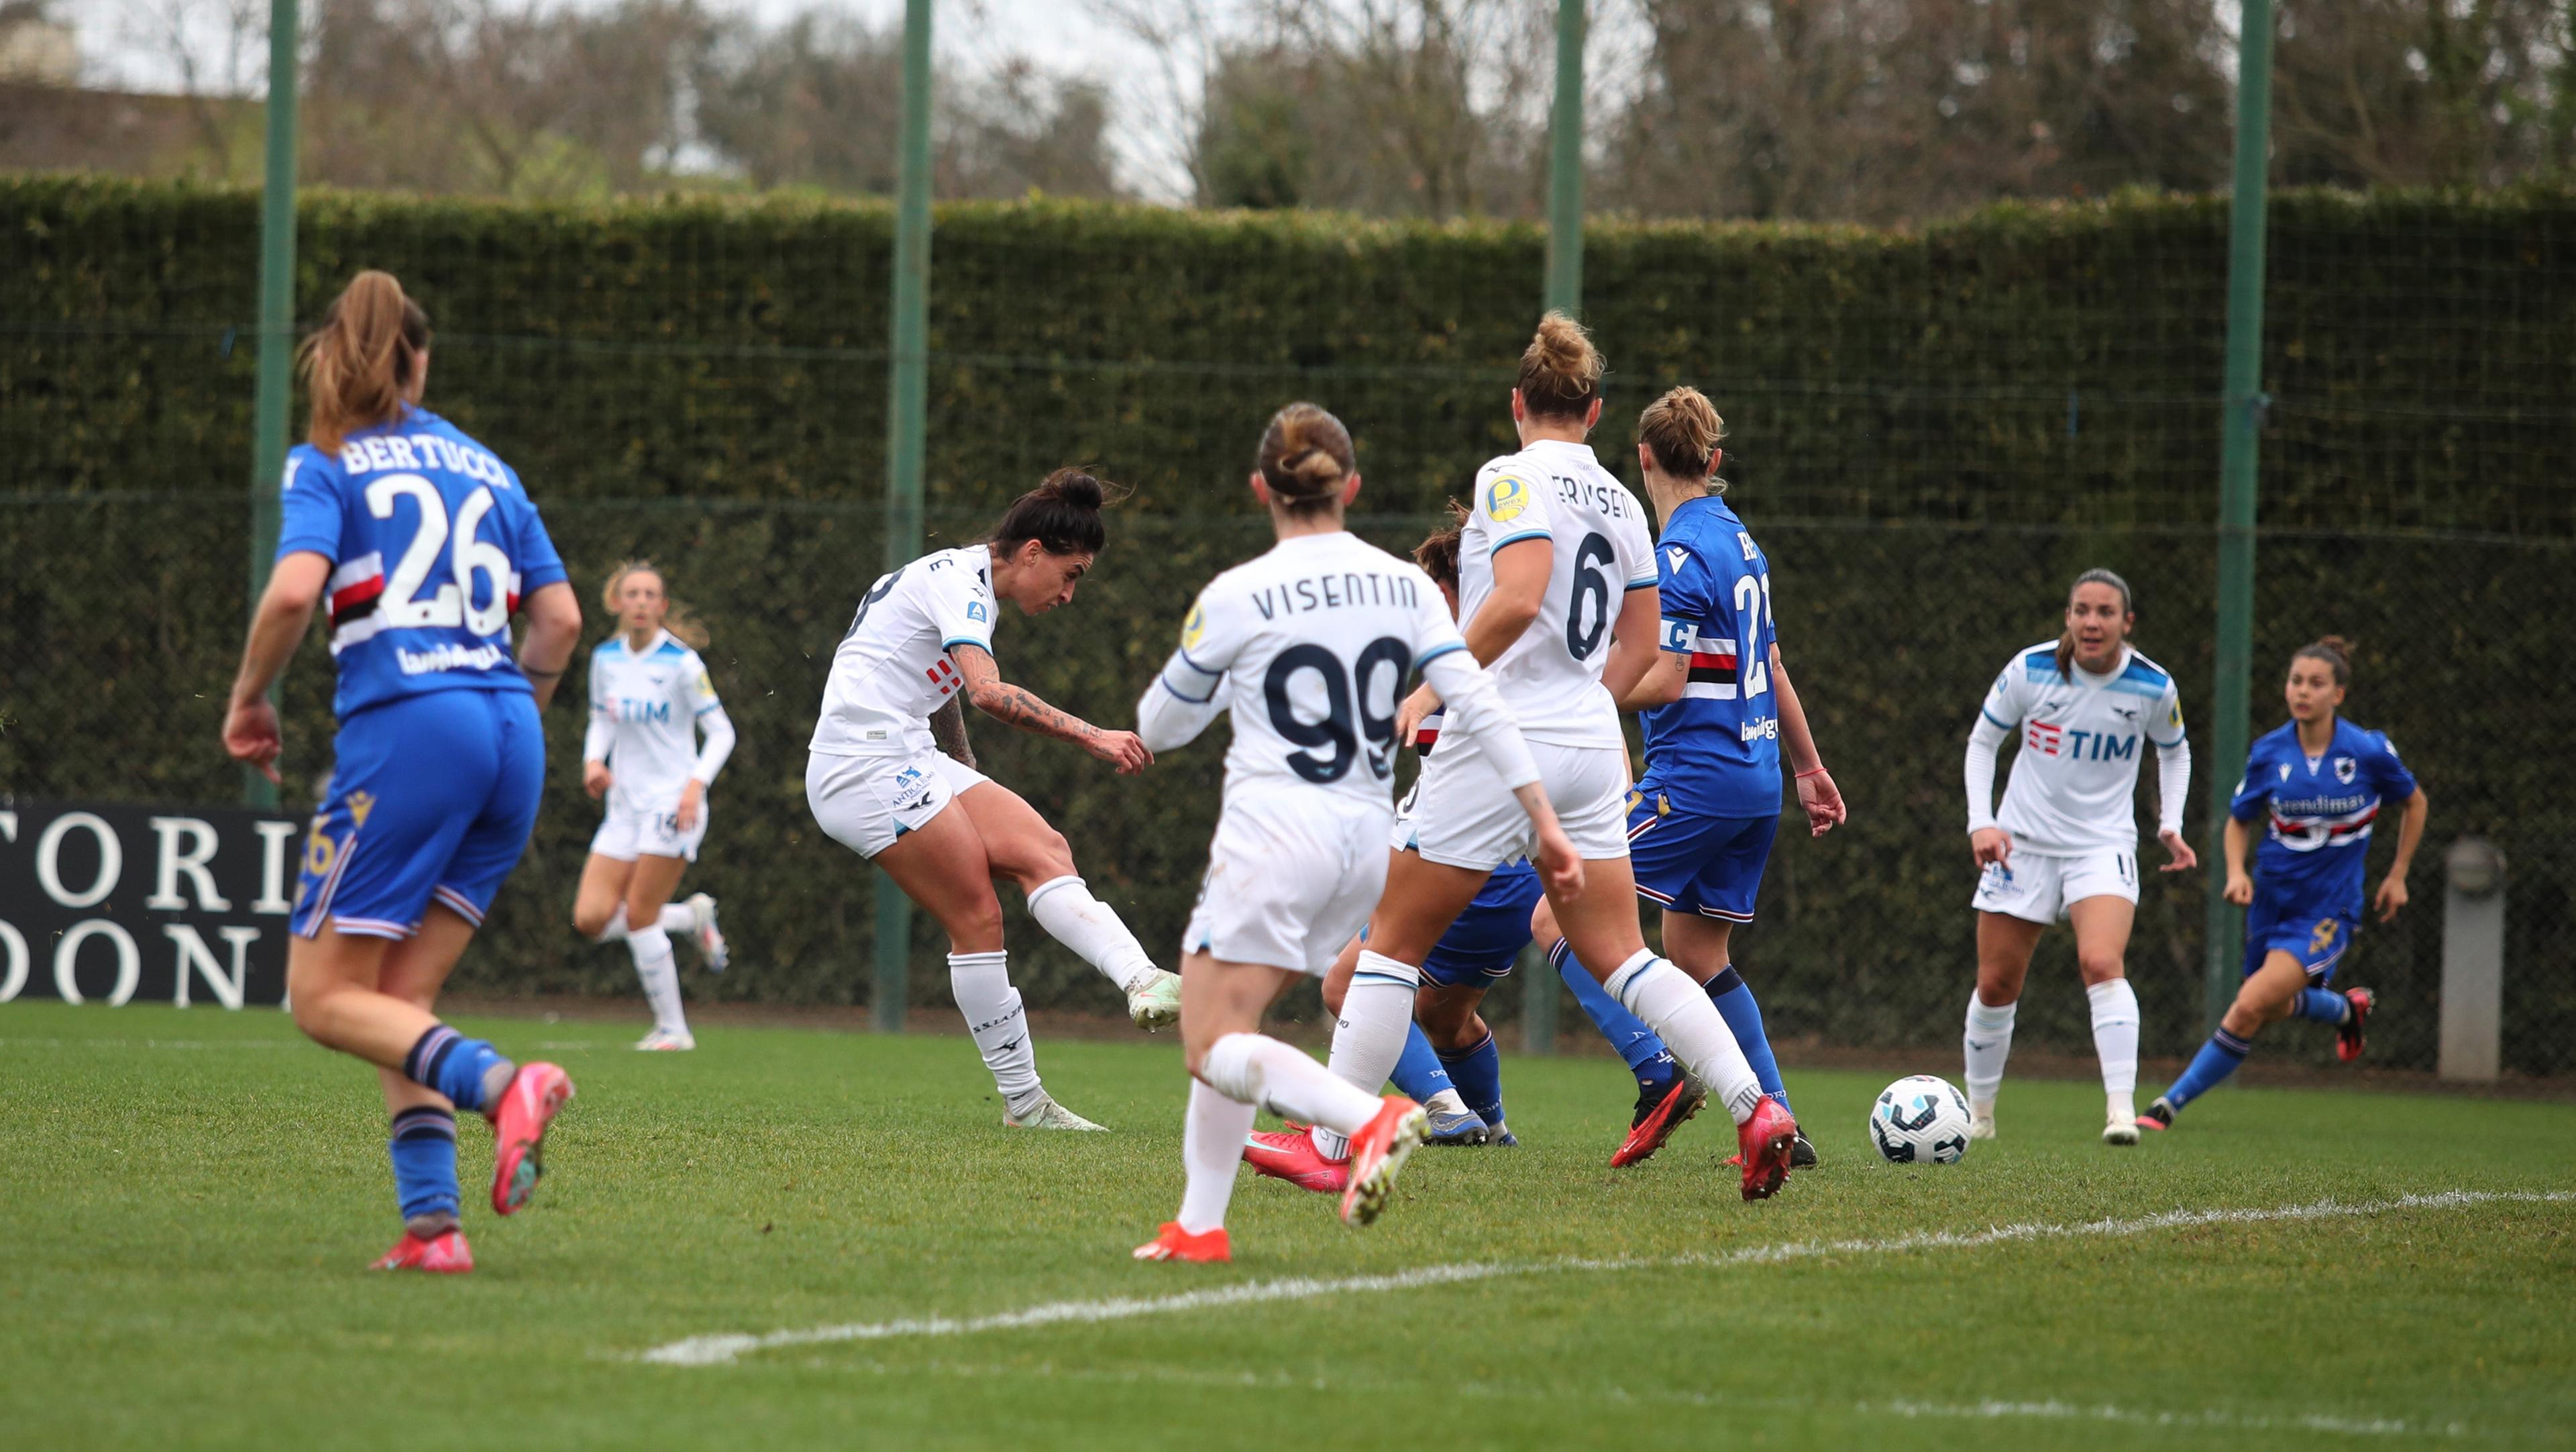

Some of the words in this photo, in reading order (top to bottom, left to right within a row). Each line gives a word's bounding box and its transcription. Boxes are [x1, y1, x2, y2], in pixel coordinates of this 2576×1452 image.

[364, 472, 513, 637] 26
[1252, 572, 1418, 621] VISENTIN
[1566, 531, 1616, 662] 6
[1669, 621, 1690, 650] C
[622, 698, 669, 724] TIM
[1264, 636, 1412, 784] 99
[2069, 730, 2137, 762] TIM
[301, 814, 335, 876] 6
[0, 918, 292, 1013] ON
